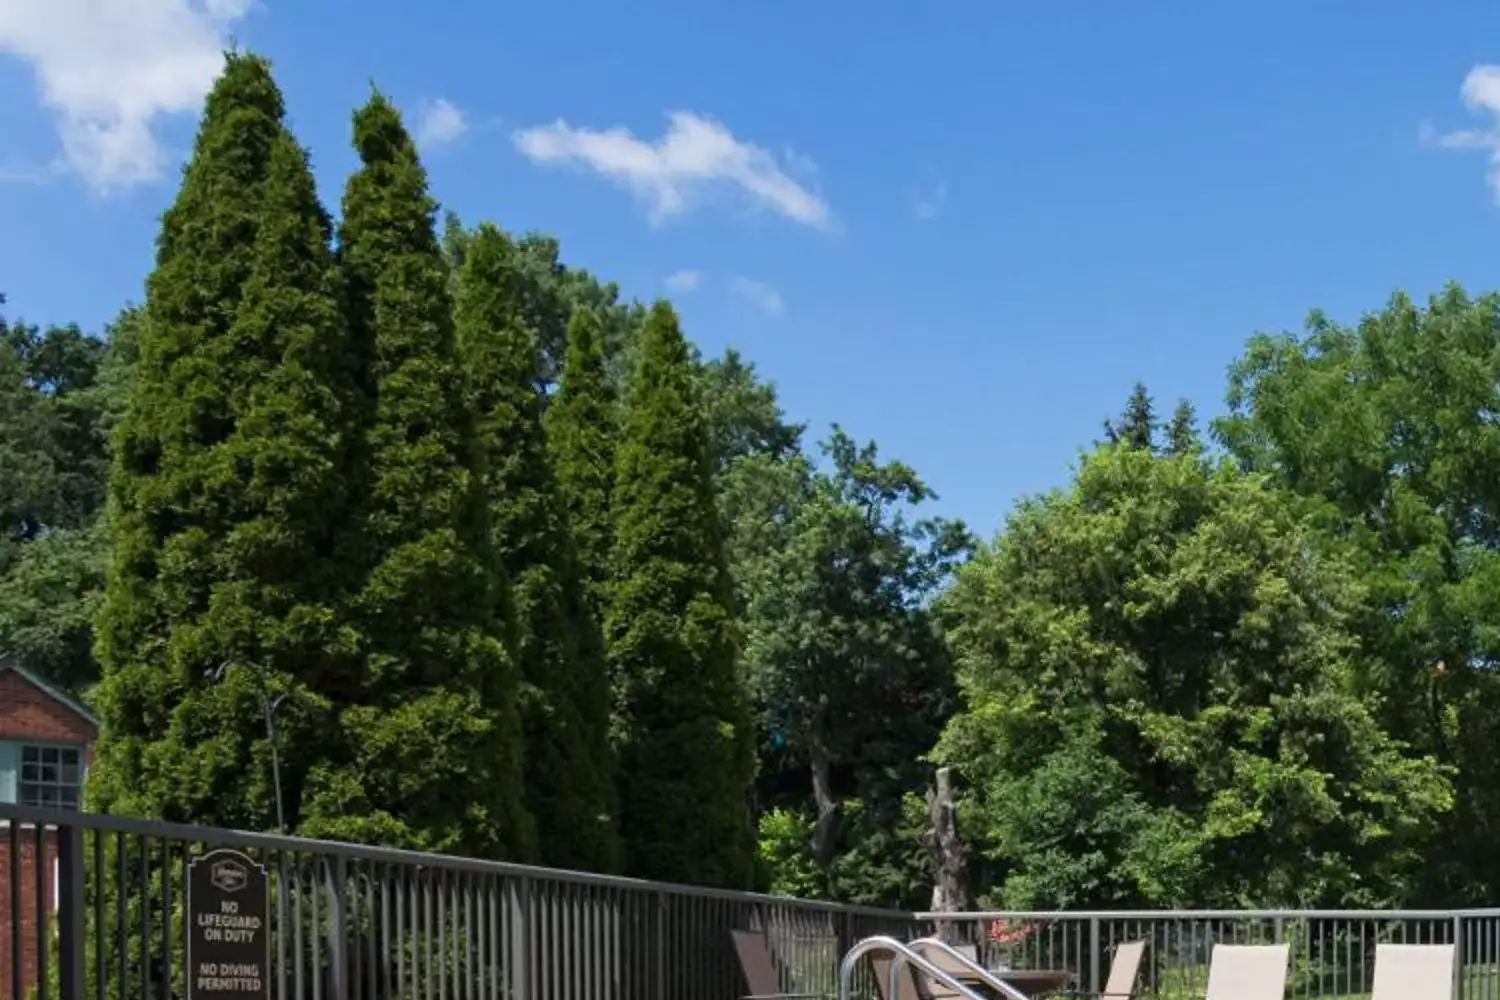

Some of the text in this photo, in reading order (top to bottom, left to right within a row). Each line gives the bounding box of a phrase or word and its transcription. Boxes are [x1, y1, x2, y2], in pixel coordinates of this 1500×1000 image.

[221, 900, 239, 914] NO
[197, 912, 262, 929] LIFEGUARD
[204, 928, 255, 943] ON DUTY
[200, 962, 259, 978] NO DIVING
[197, 976, 262, 991] PERMITTED
